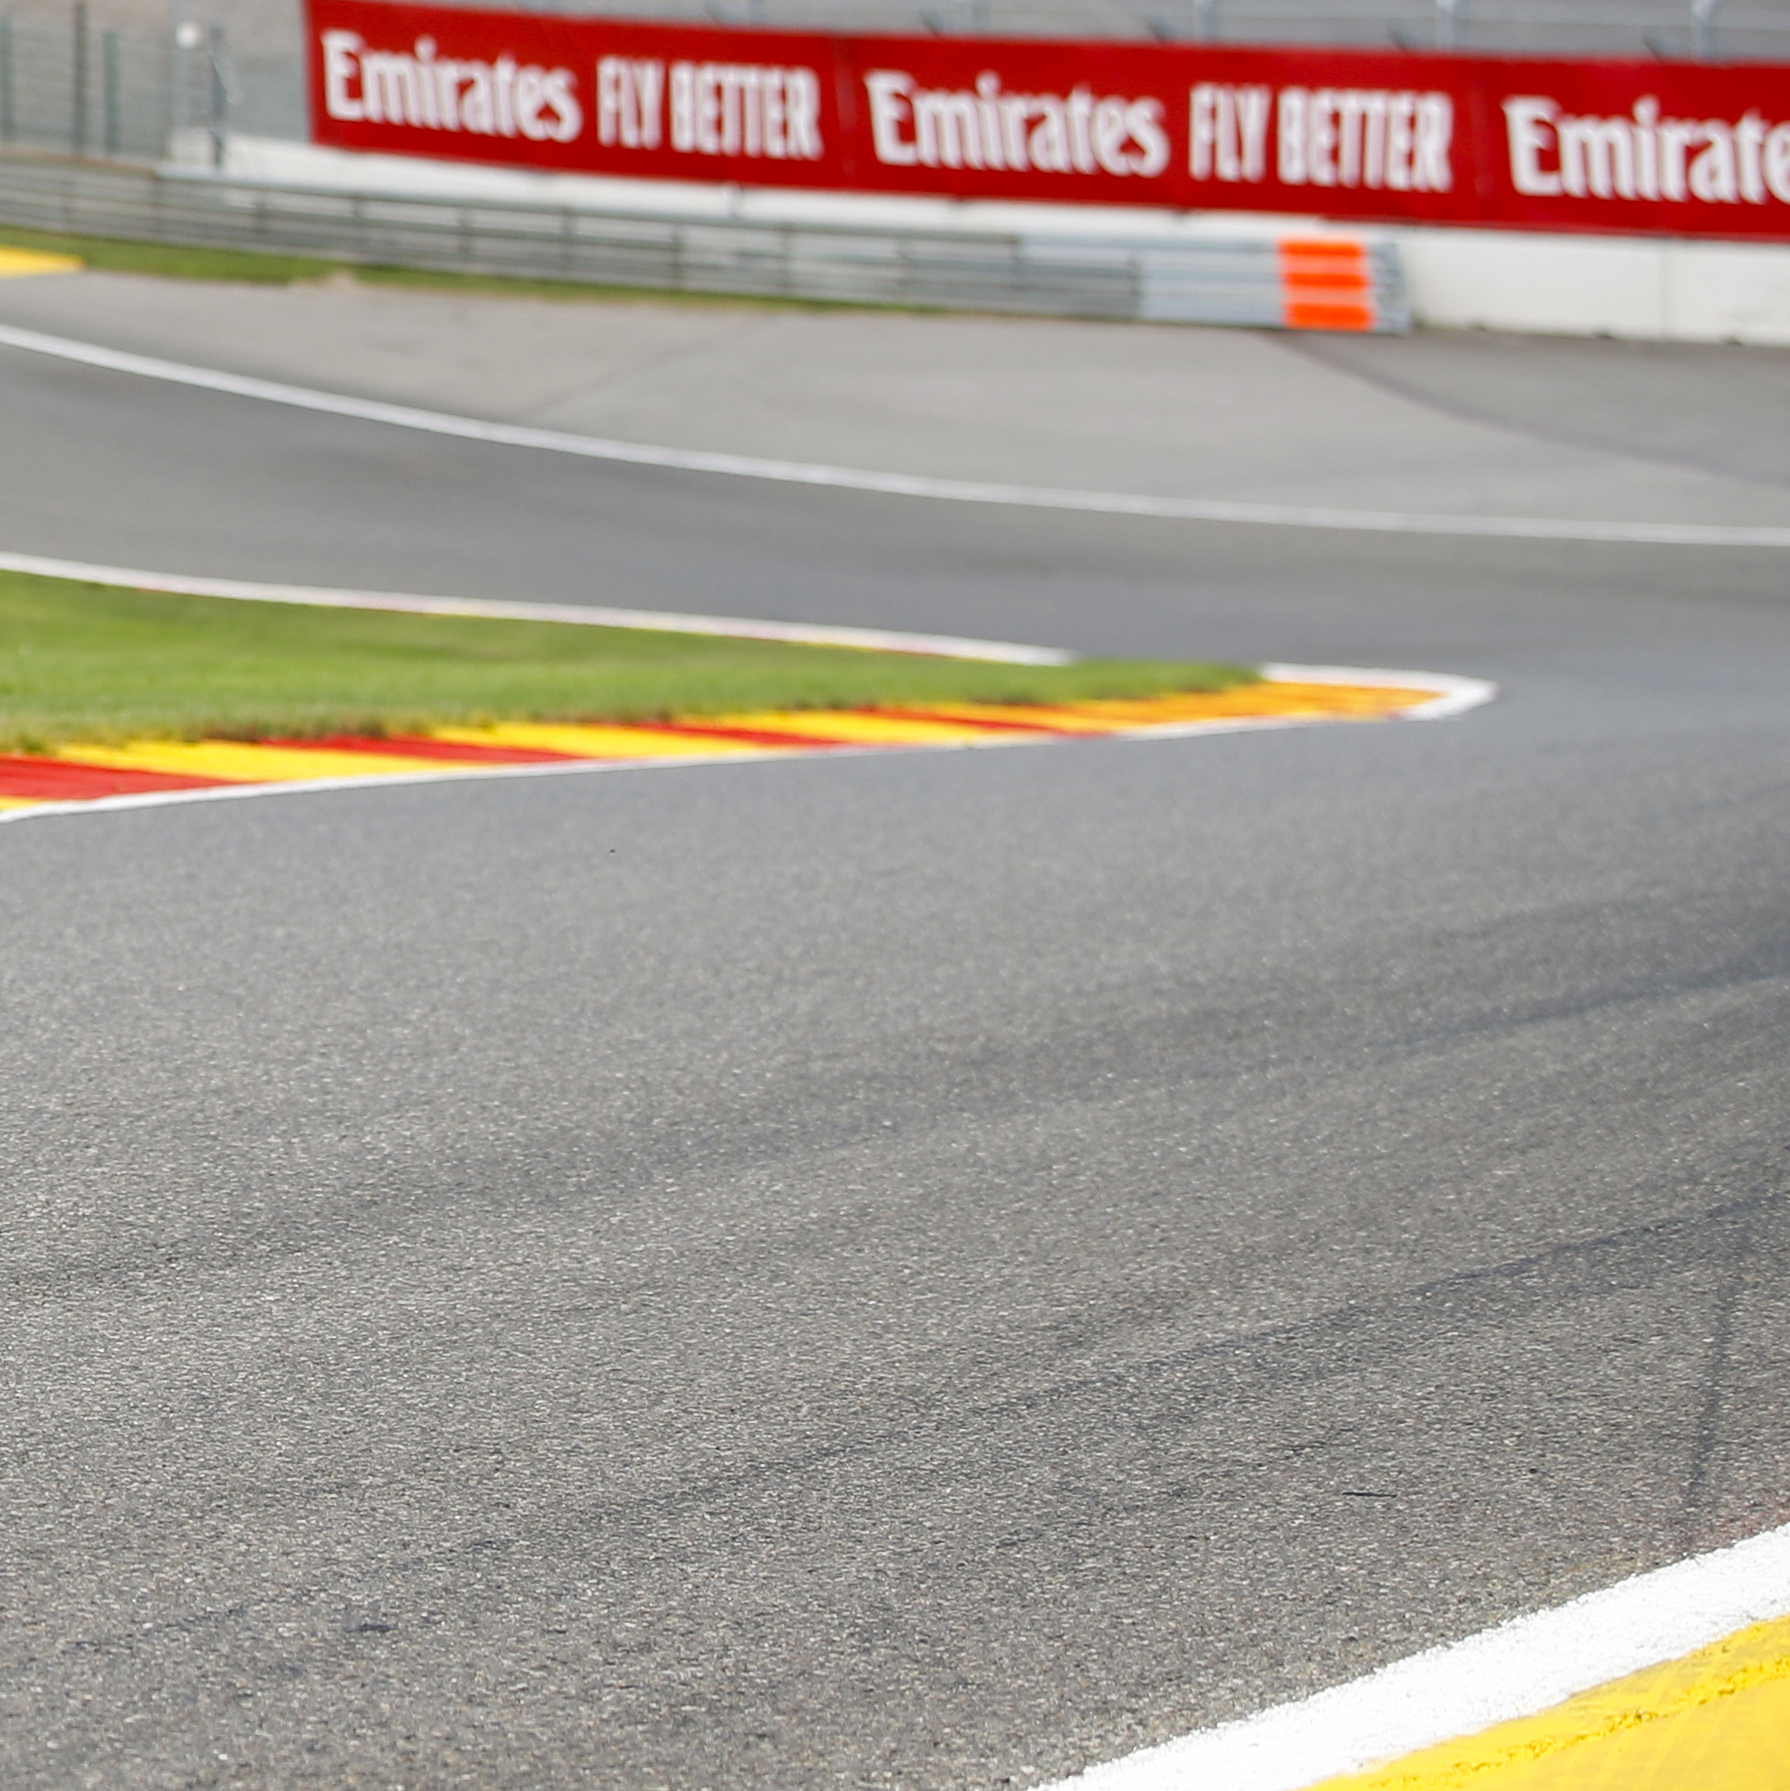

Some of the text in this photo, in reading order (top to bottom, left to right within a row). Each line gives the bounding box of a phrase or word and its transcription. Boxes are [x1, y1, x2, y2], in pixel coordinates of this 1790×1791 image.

[321, 28, 583, 143] Emirates
[597, 55, 665, 150] FLY
[669, 60, 823, 161] BETTER
[865, 69, 1170, 178] Emirates
[1189, 81, 1271, 182] FLY
[1277, 86, 1453, 193] BETTER
